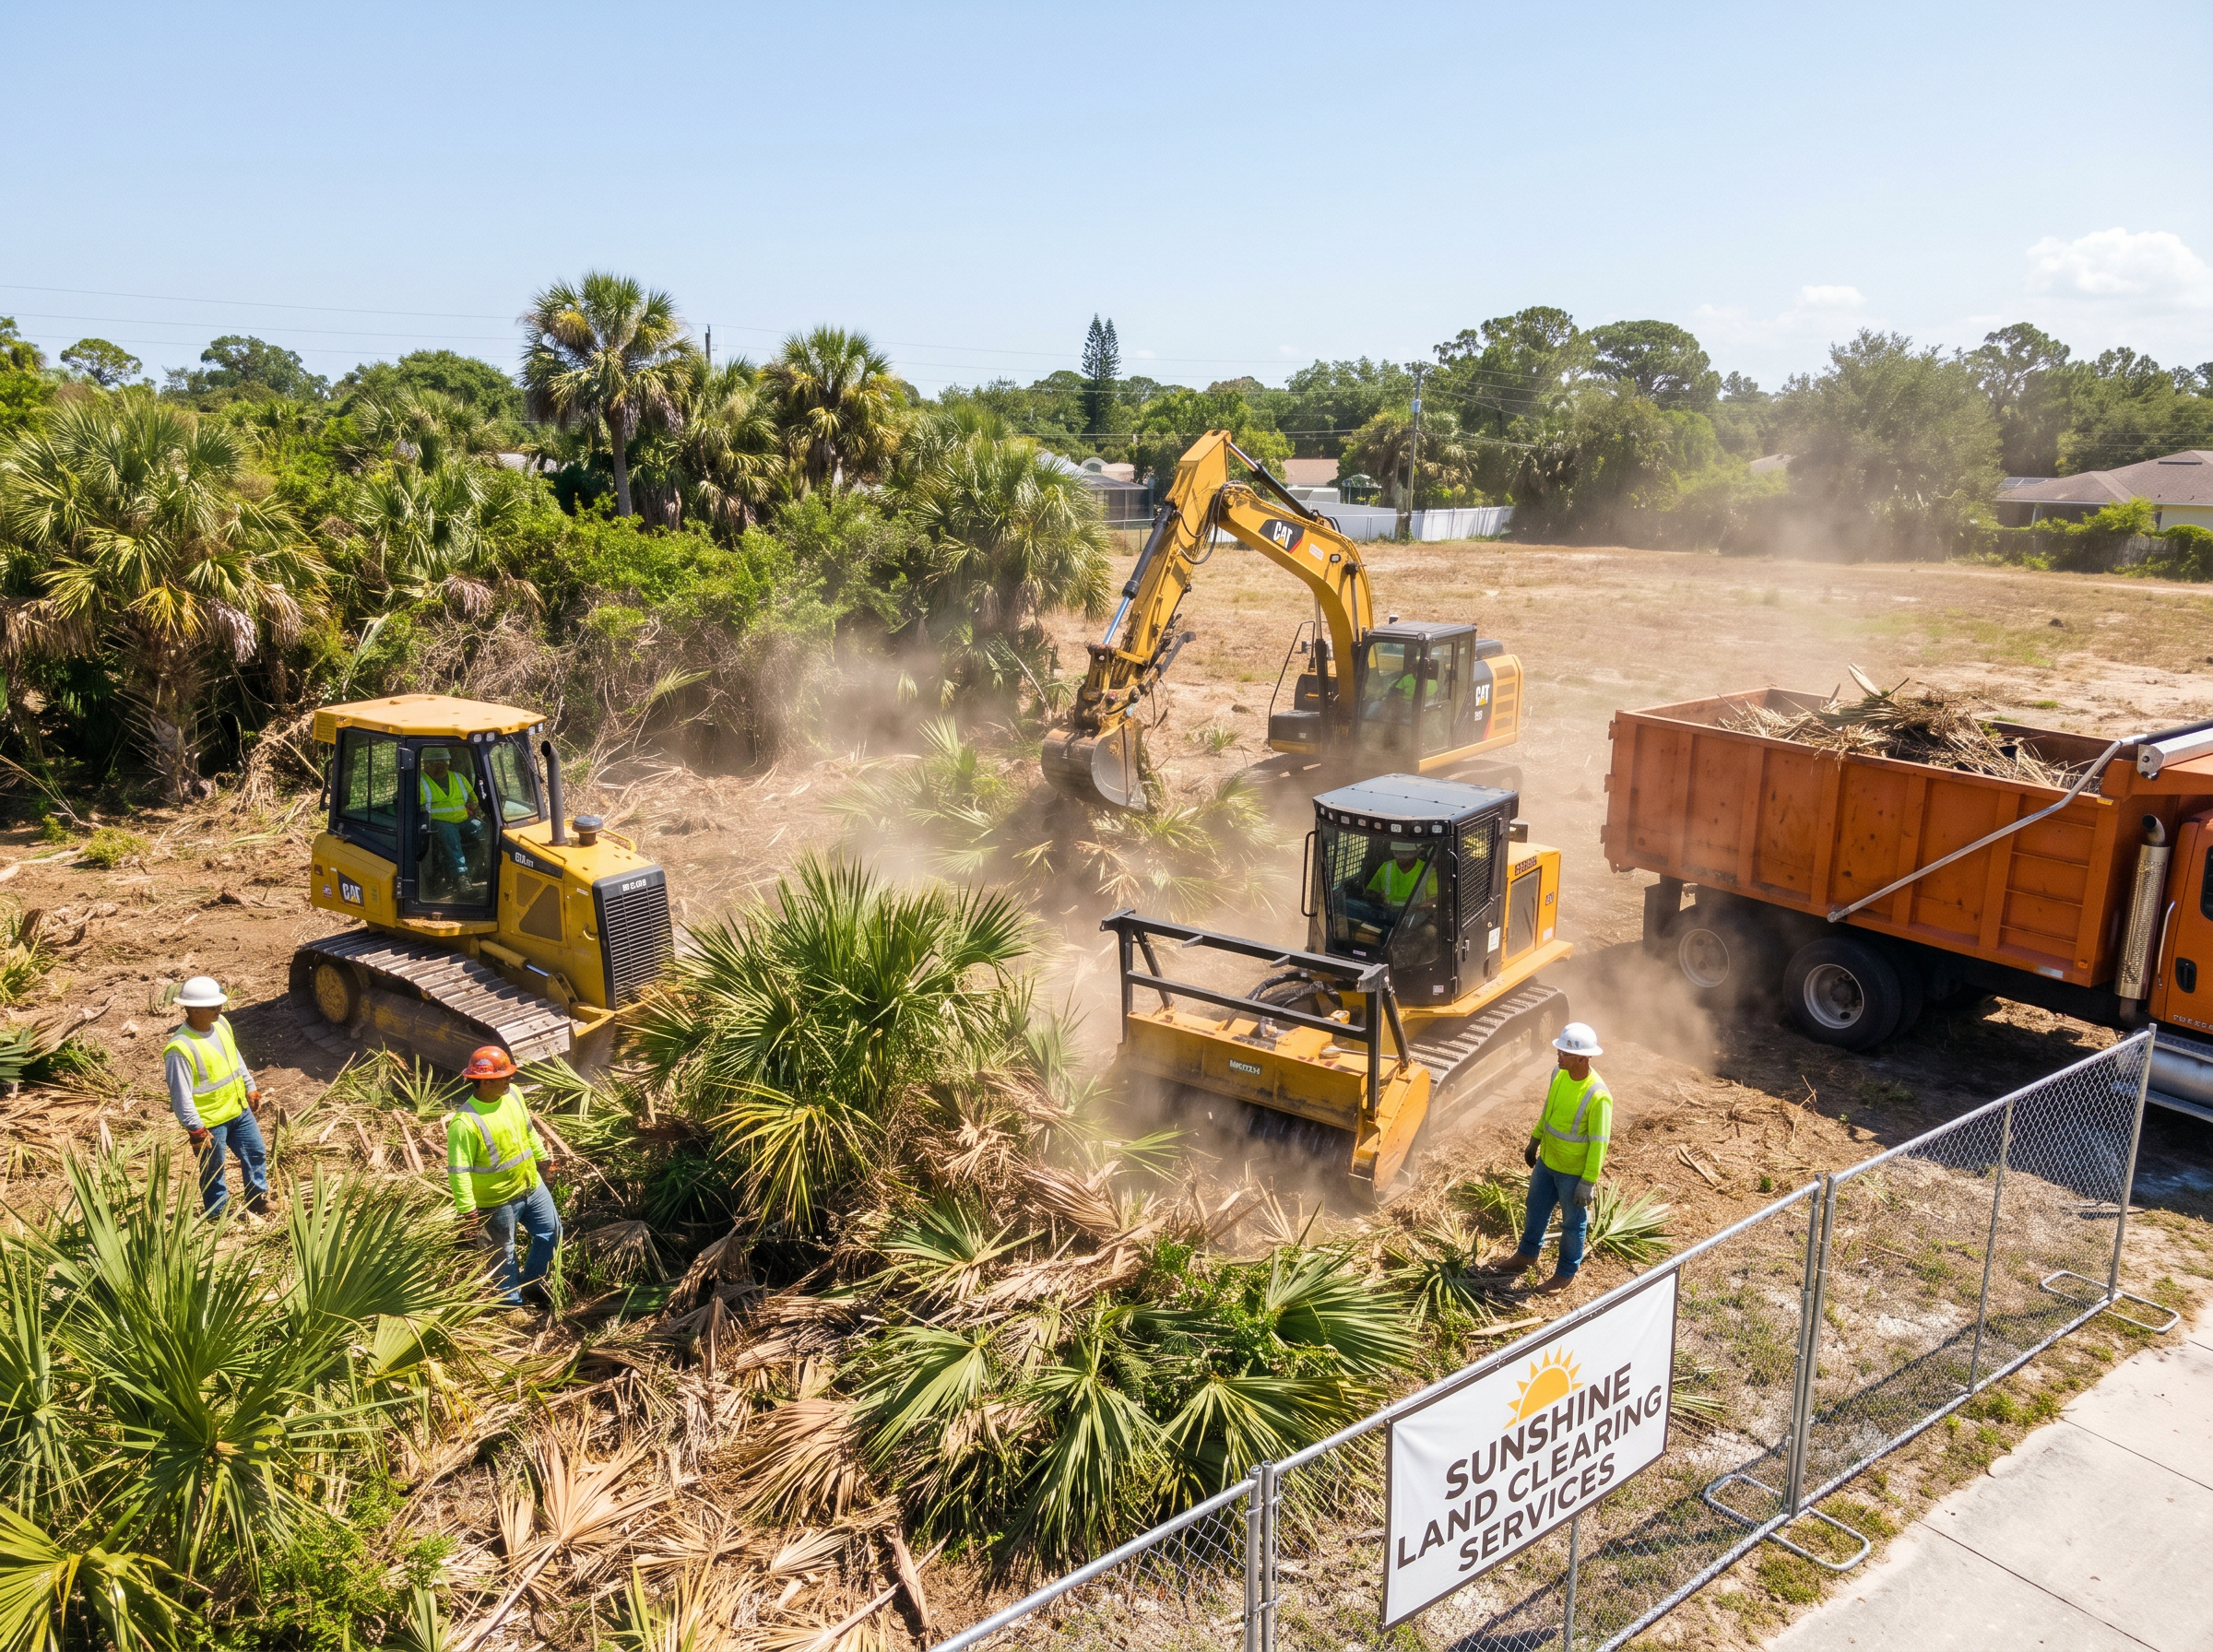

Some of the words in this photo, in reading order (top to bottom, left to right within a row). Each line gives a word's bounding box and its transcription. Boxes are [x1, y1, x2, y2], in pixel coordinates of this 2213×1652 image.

[1273, 522, 1293, 549] CAT
[1475, 684, 1489, 706] CAT
[342, 882, 361, 903] CAT
[1445, 1362, 1632, 1500] SUNSHINE
[1397, 1490, 1497, 1570] LAND
[1508, 1385, 1662, 1503] CLEARING
[1458, 1452, 1615, 1572] SERVICES
